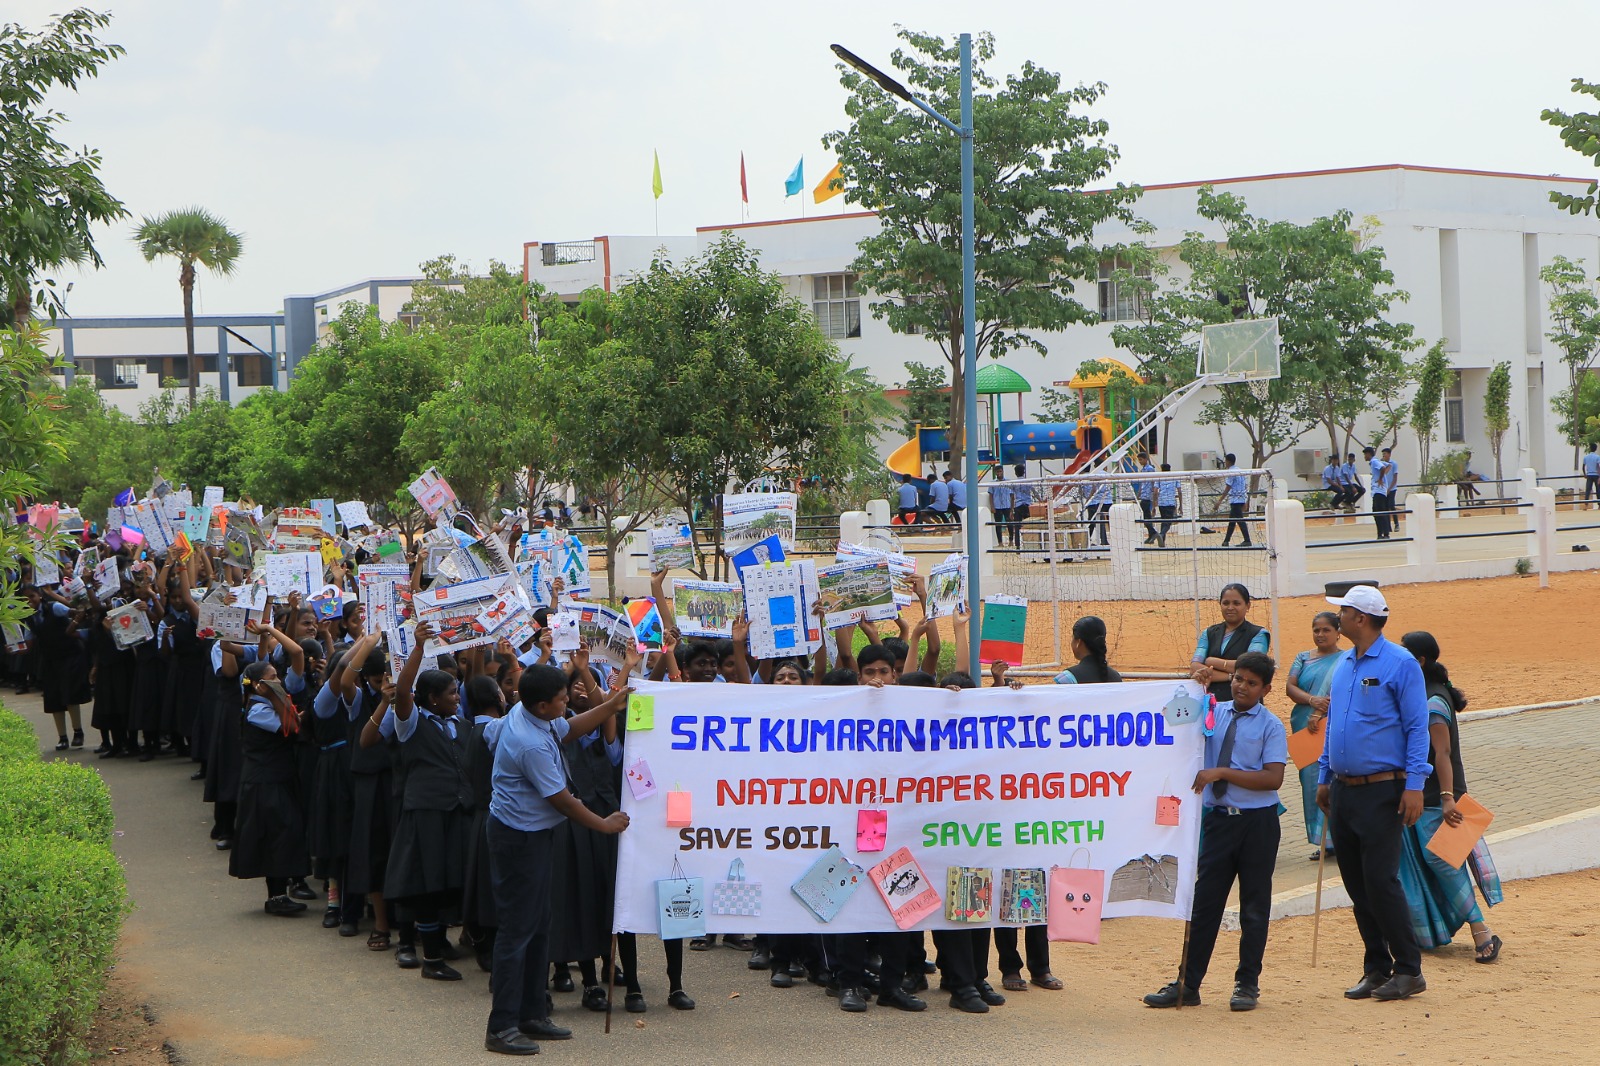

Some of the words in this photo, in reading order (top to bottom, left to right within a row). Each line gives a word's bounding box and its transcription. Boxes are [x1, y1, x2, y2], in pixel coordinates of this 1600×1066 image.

[670, 715, 752, 753] SRI
[1058, 711, 1175, 748] SCHOOL
[1000, 772, 1065, 801] BAG
[1070, 771, 1132, 799] DAY
[678, 827, 753, 852] SAVE
[764, 825, 840, 852] SOIL
[922, 821, 1002, 847] SAVE
[1015, 820, 1104, 846] EARTH
